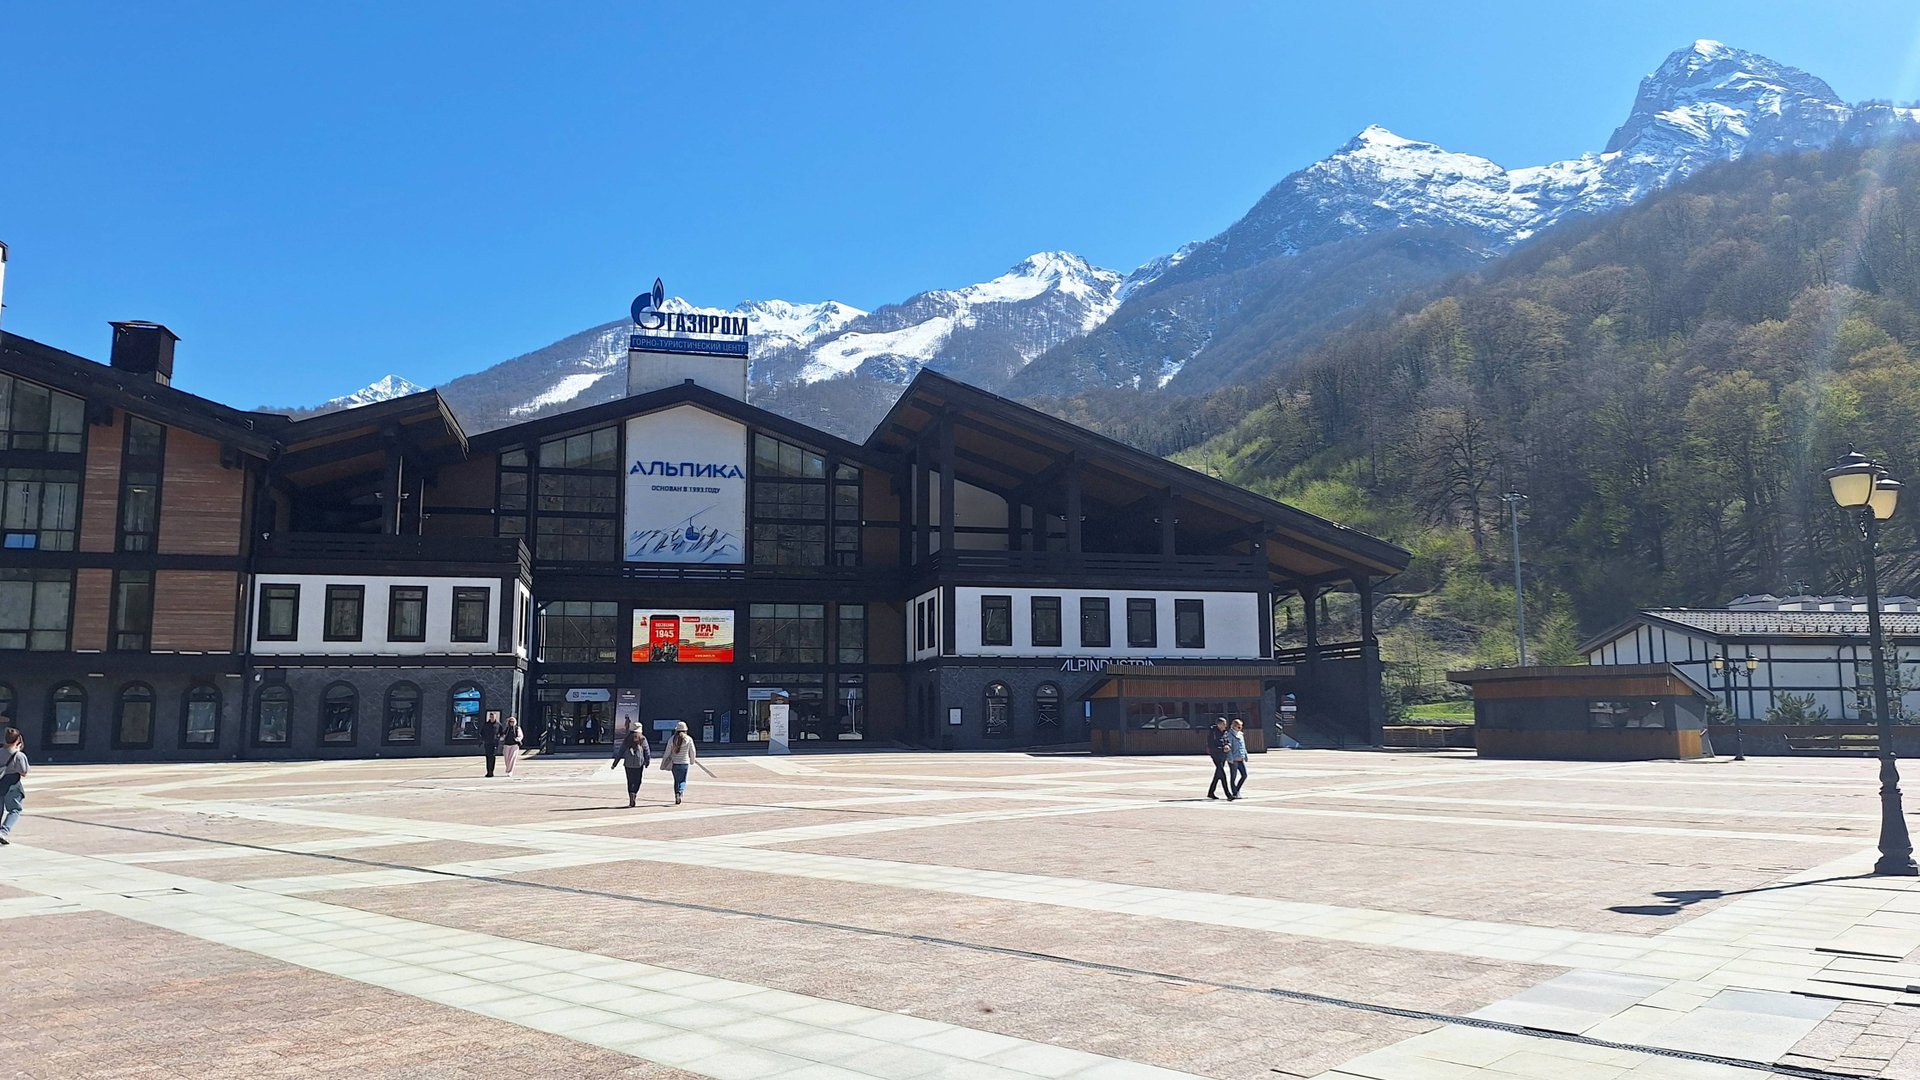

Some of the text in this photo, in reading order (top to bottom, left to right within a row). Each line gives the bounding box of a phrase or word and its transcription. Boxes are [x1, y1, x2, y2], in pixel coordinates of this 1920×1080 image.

[667, 312, 748, 336] ГАЗПРОМ
[632, 338, 746, 352] ГОРНО-ТУРИСТИЧЕСКИЙ ЦЕНТР
[630, 460, 745, 479] АЛЬПИКА
[655, 629, 675, 639] 1945
